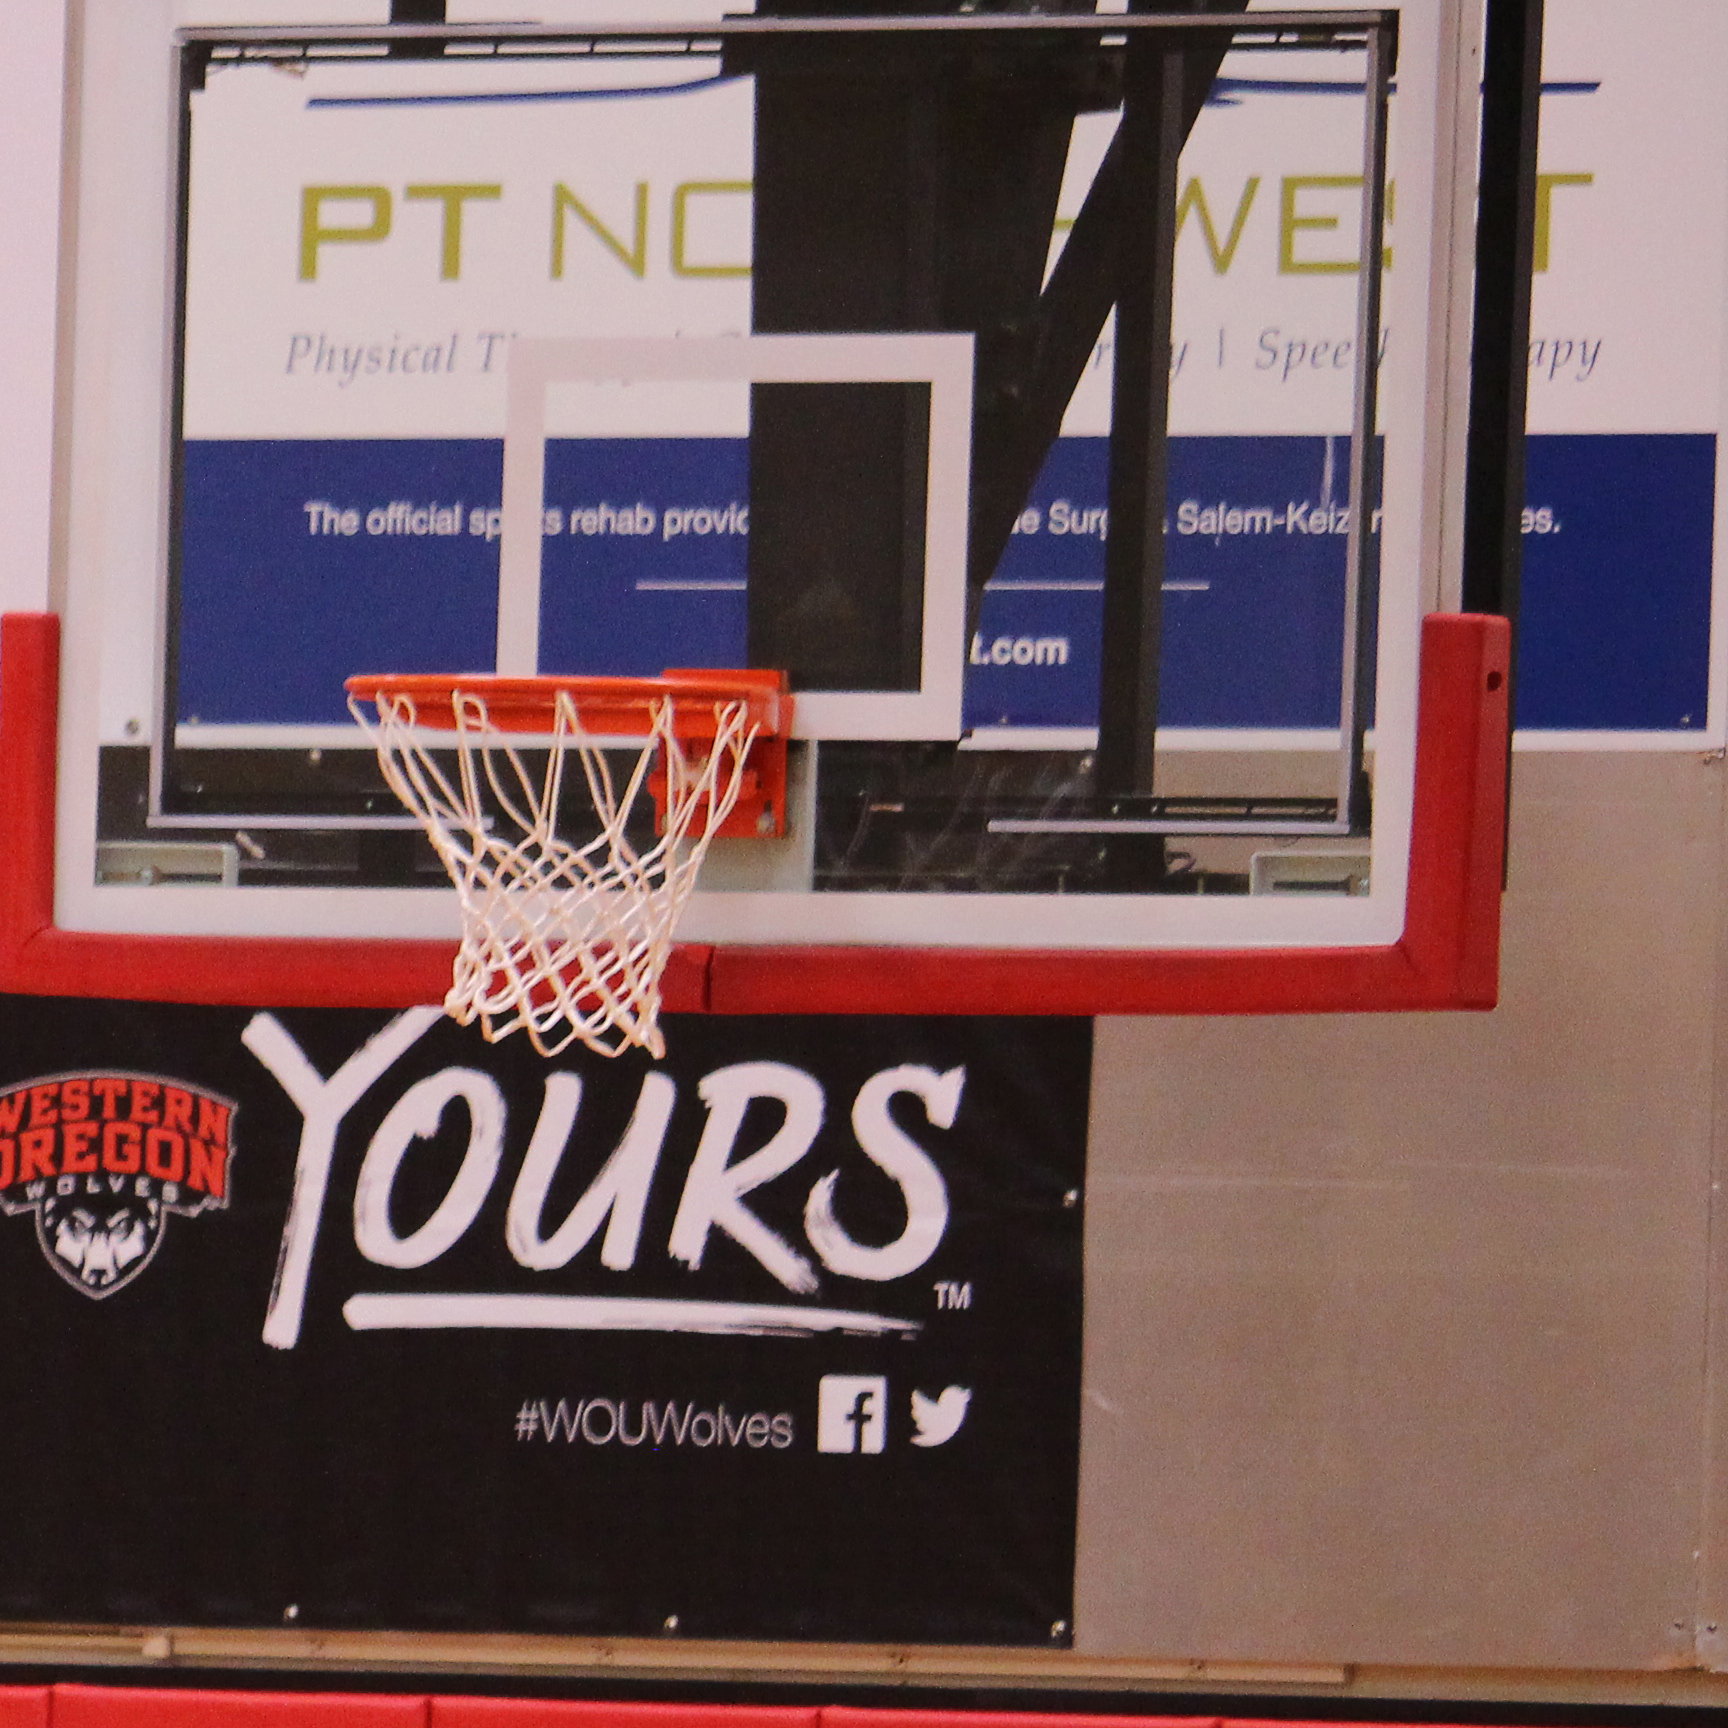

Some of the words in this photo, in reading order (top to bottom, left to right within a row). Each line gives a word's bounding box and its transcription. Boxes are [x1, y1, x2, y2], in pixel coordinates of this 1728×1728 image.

[297, 183, 503, 282] PT
[285, 332, 459, 388] Physical
[304, 502, 359, 536] The
[366, 502, 463, 537] official
[570, 502, 656, 537] rehab
[26, 1173, 180, 1204] WOLVES
[241, 1005, 966, 1350] YOURS
[515, 1398, 795, 1449] #WOUWolves
